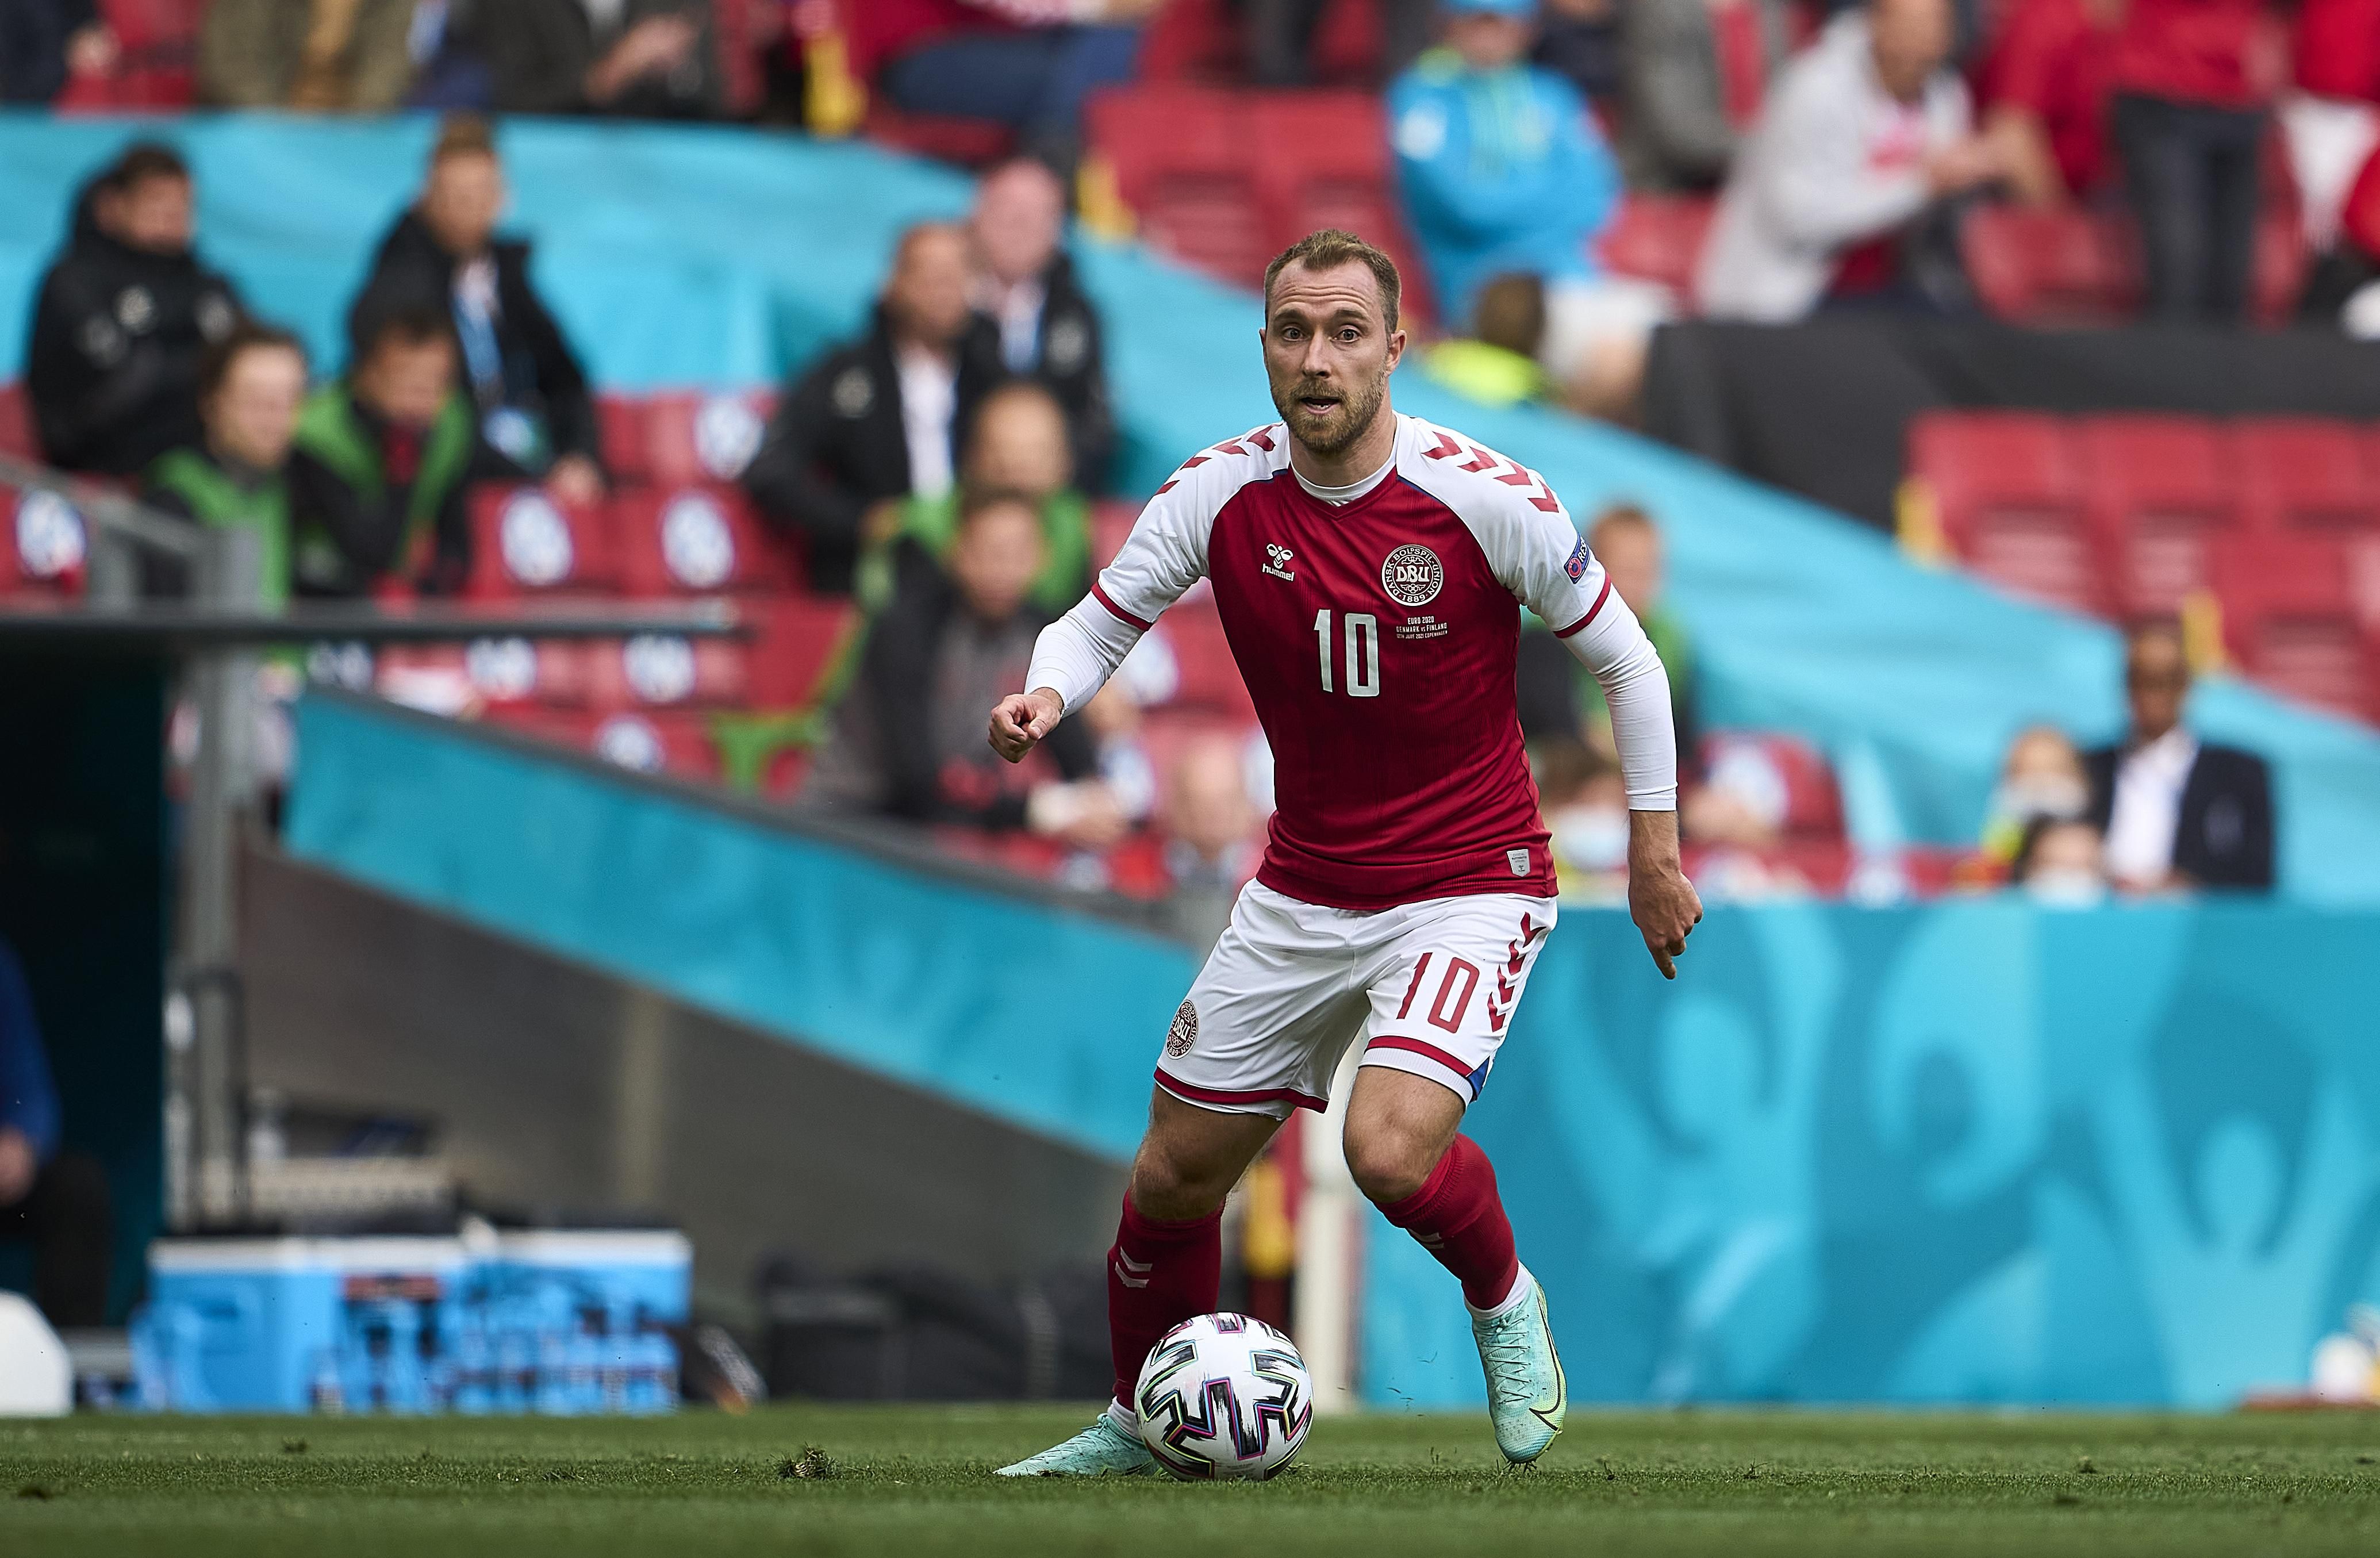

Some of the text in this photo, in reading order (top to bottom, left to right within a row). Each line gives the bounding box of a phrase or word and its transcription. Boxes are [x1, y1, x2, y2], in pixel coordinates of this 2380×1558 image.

[1262, 563, 1295, 581] hummel
[1385, 562, 1400, 596] DANSK
[1396, 565, 1430, 583] DBU
[1402, 594, 1426, 603] 1889
[1407, 616, 1434, 625] EURO 2020
[1426, 622, 1447, 631] FINLAND
[1314, 609, 1380, 697] 10
[1396, 951, 1480, 1034] 10
